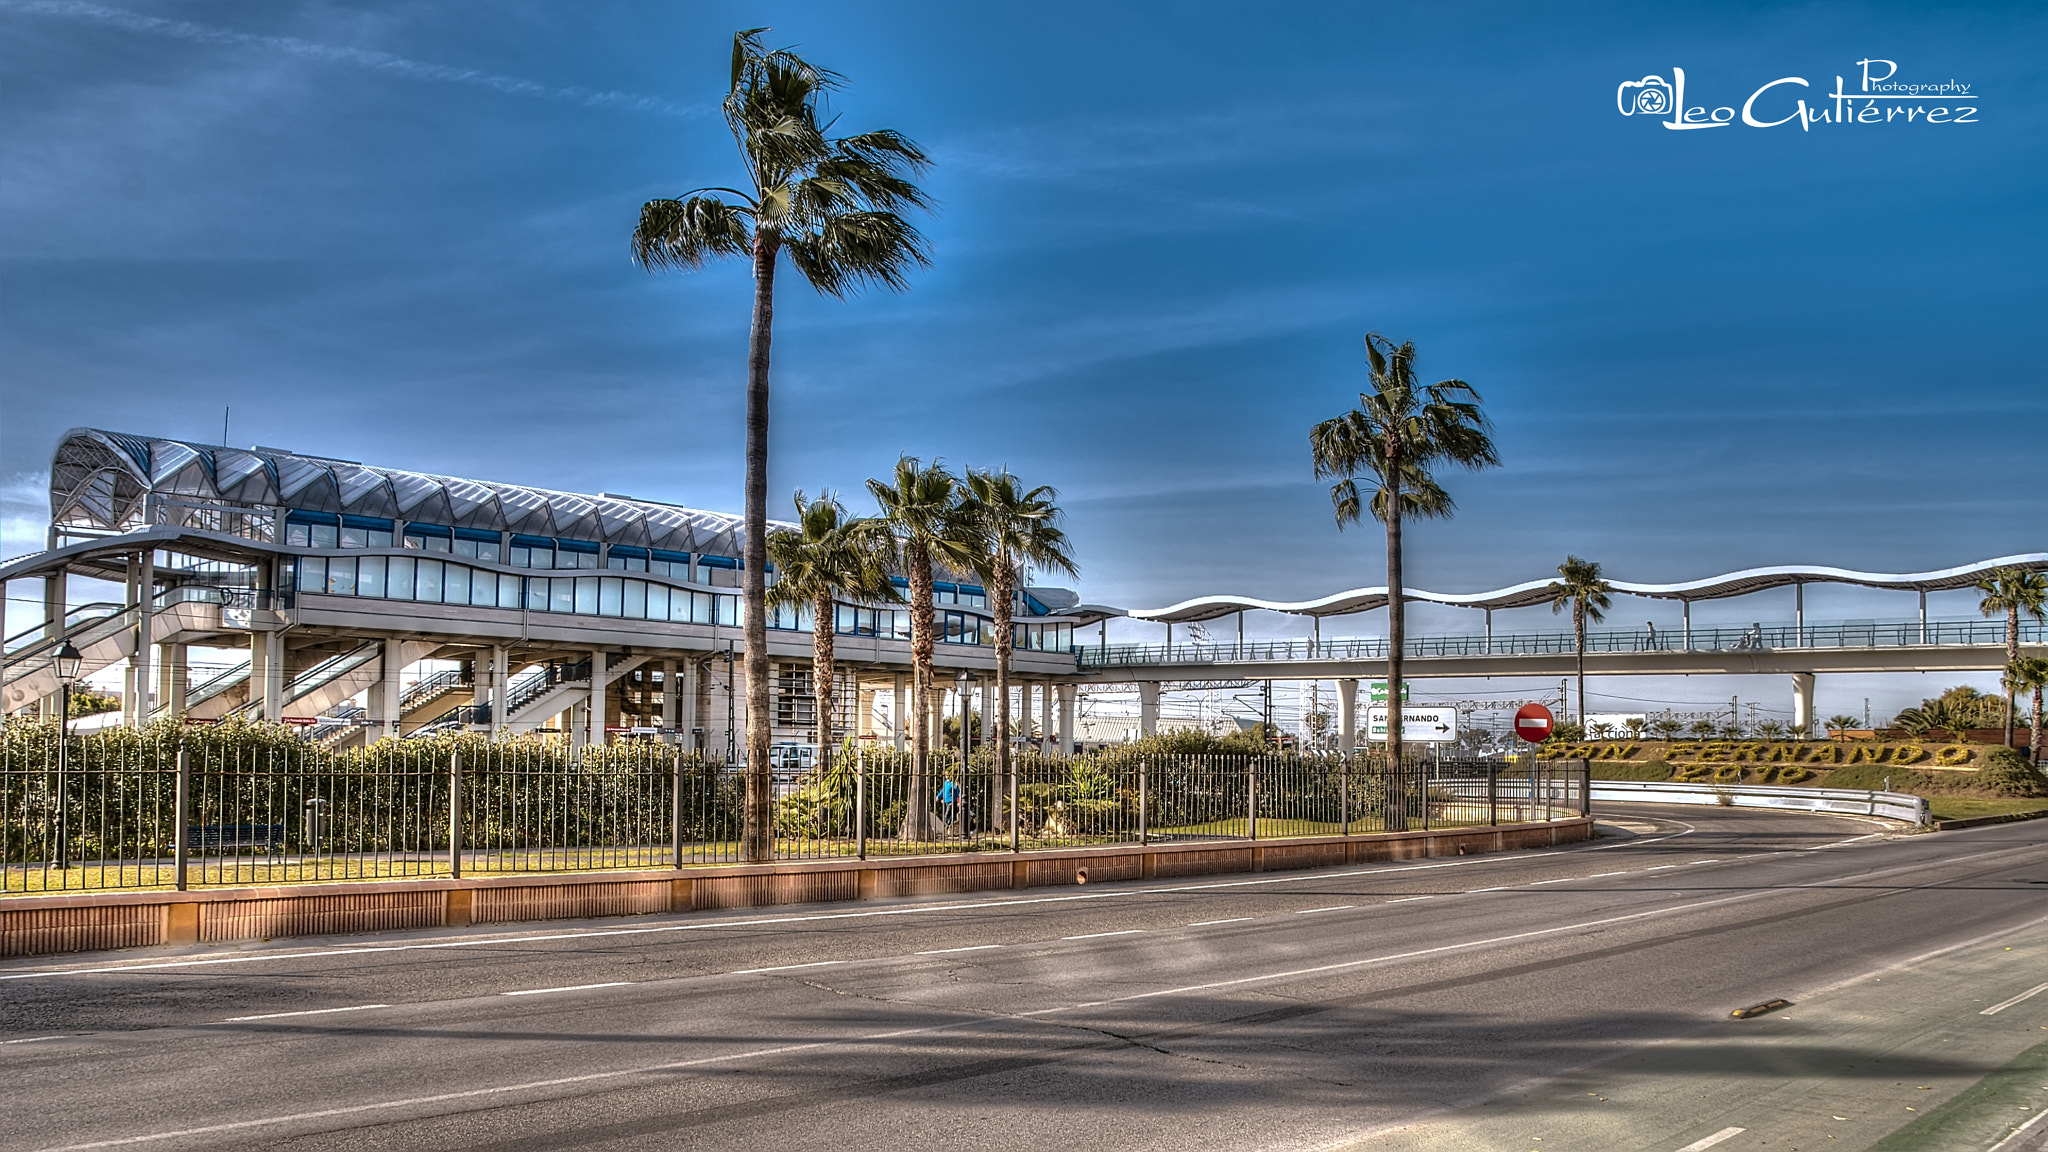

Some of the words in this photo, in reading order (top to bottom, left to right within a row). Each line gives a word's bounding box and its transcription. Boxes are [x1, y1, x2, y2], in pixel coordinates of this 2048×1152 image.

[1534, 742, 1635, 759] SAN
[1663, 741, 1969, 766] FERNANDO
[1674, 763, 1808, 784] 2010
